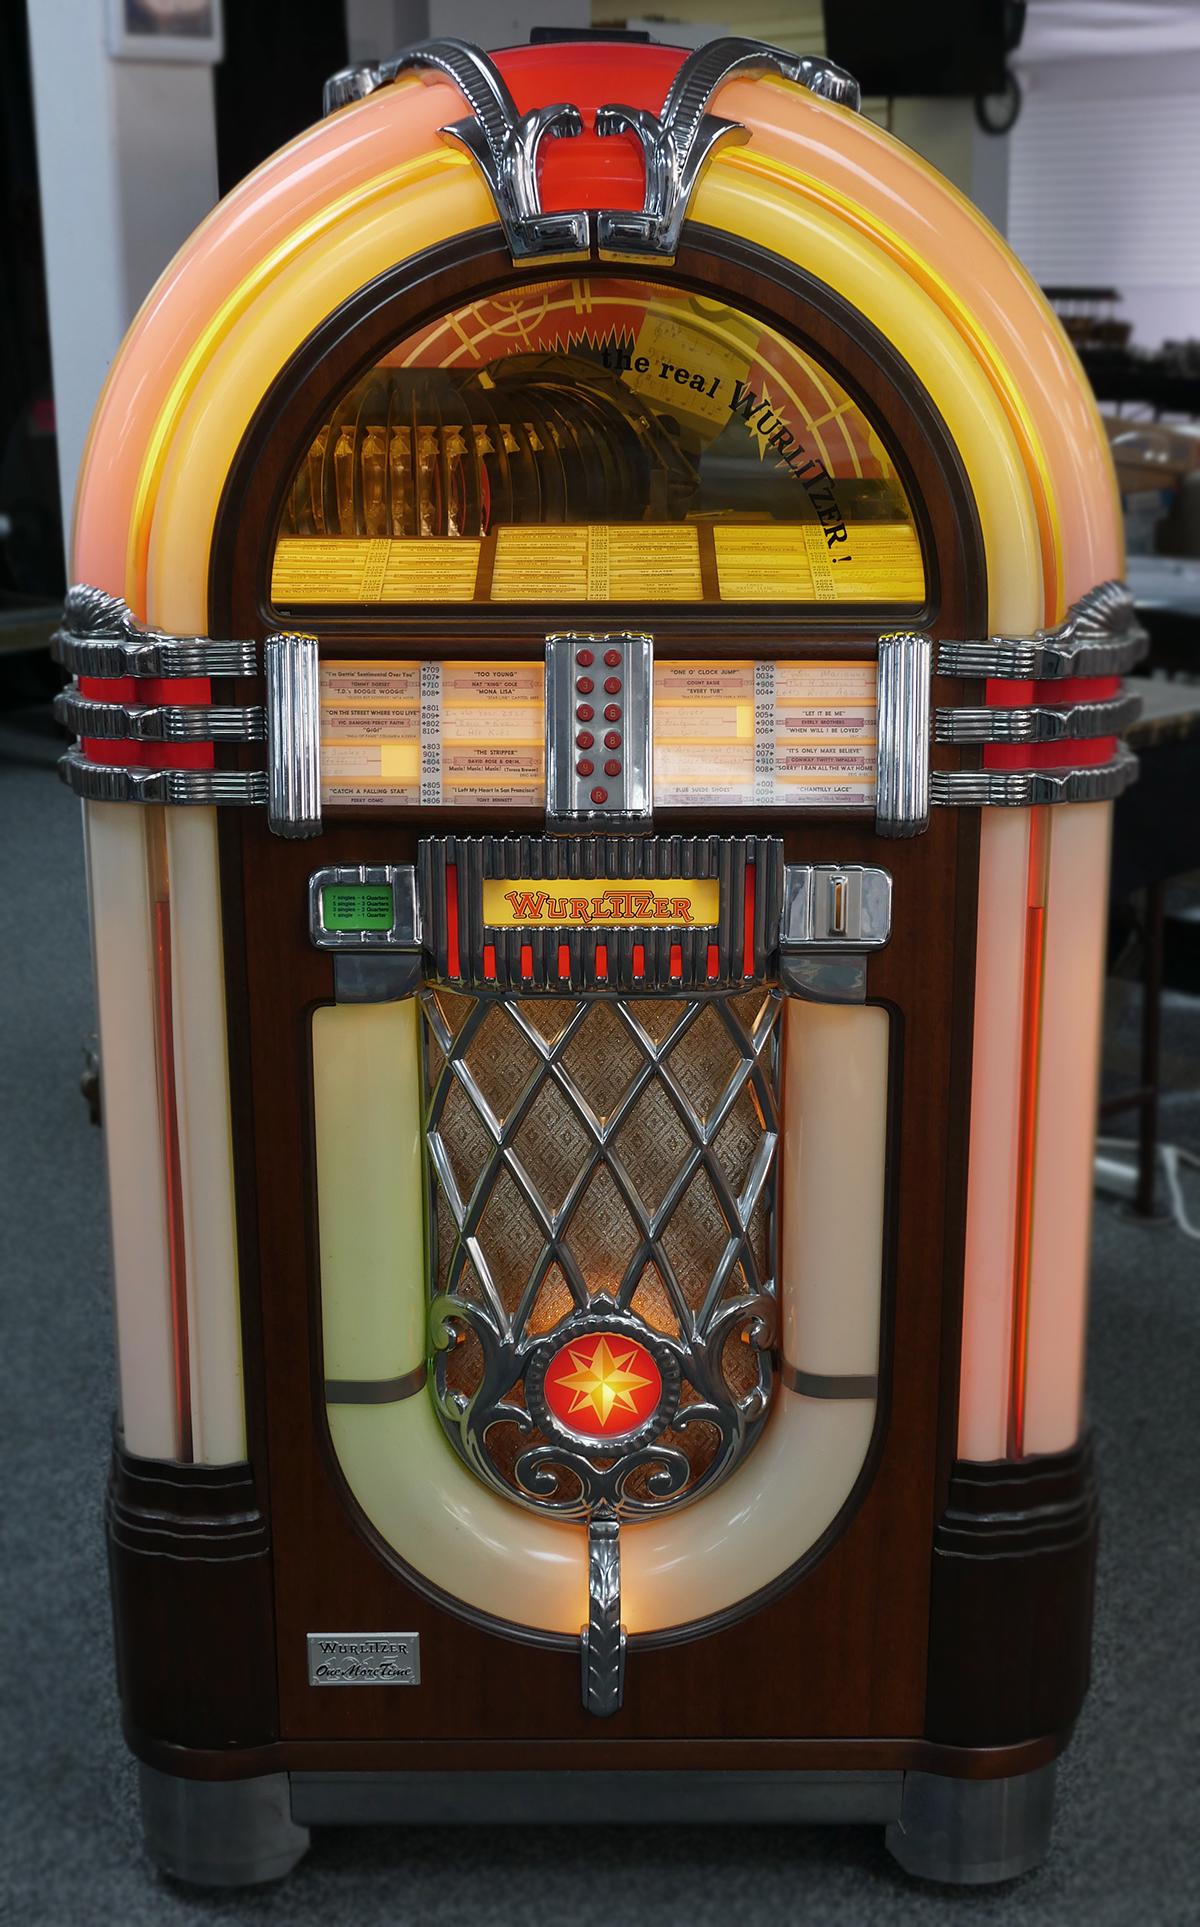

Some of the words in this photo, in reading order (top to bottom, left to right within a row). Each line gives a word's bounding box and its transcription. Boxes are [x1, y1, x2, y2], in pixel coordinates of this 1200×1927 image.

[601, 348, 650, 374] the
[658, 362, 721, 399] real
[504, 890, 694, 924] WURLITZER
[318, 1640, 409, 1656] WURLITZER
[316, 1663, 340, 1677] One
[341, 1663, 380, 1677] More
[380, 1663, 412, 1677] Time
